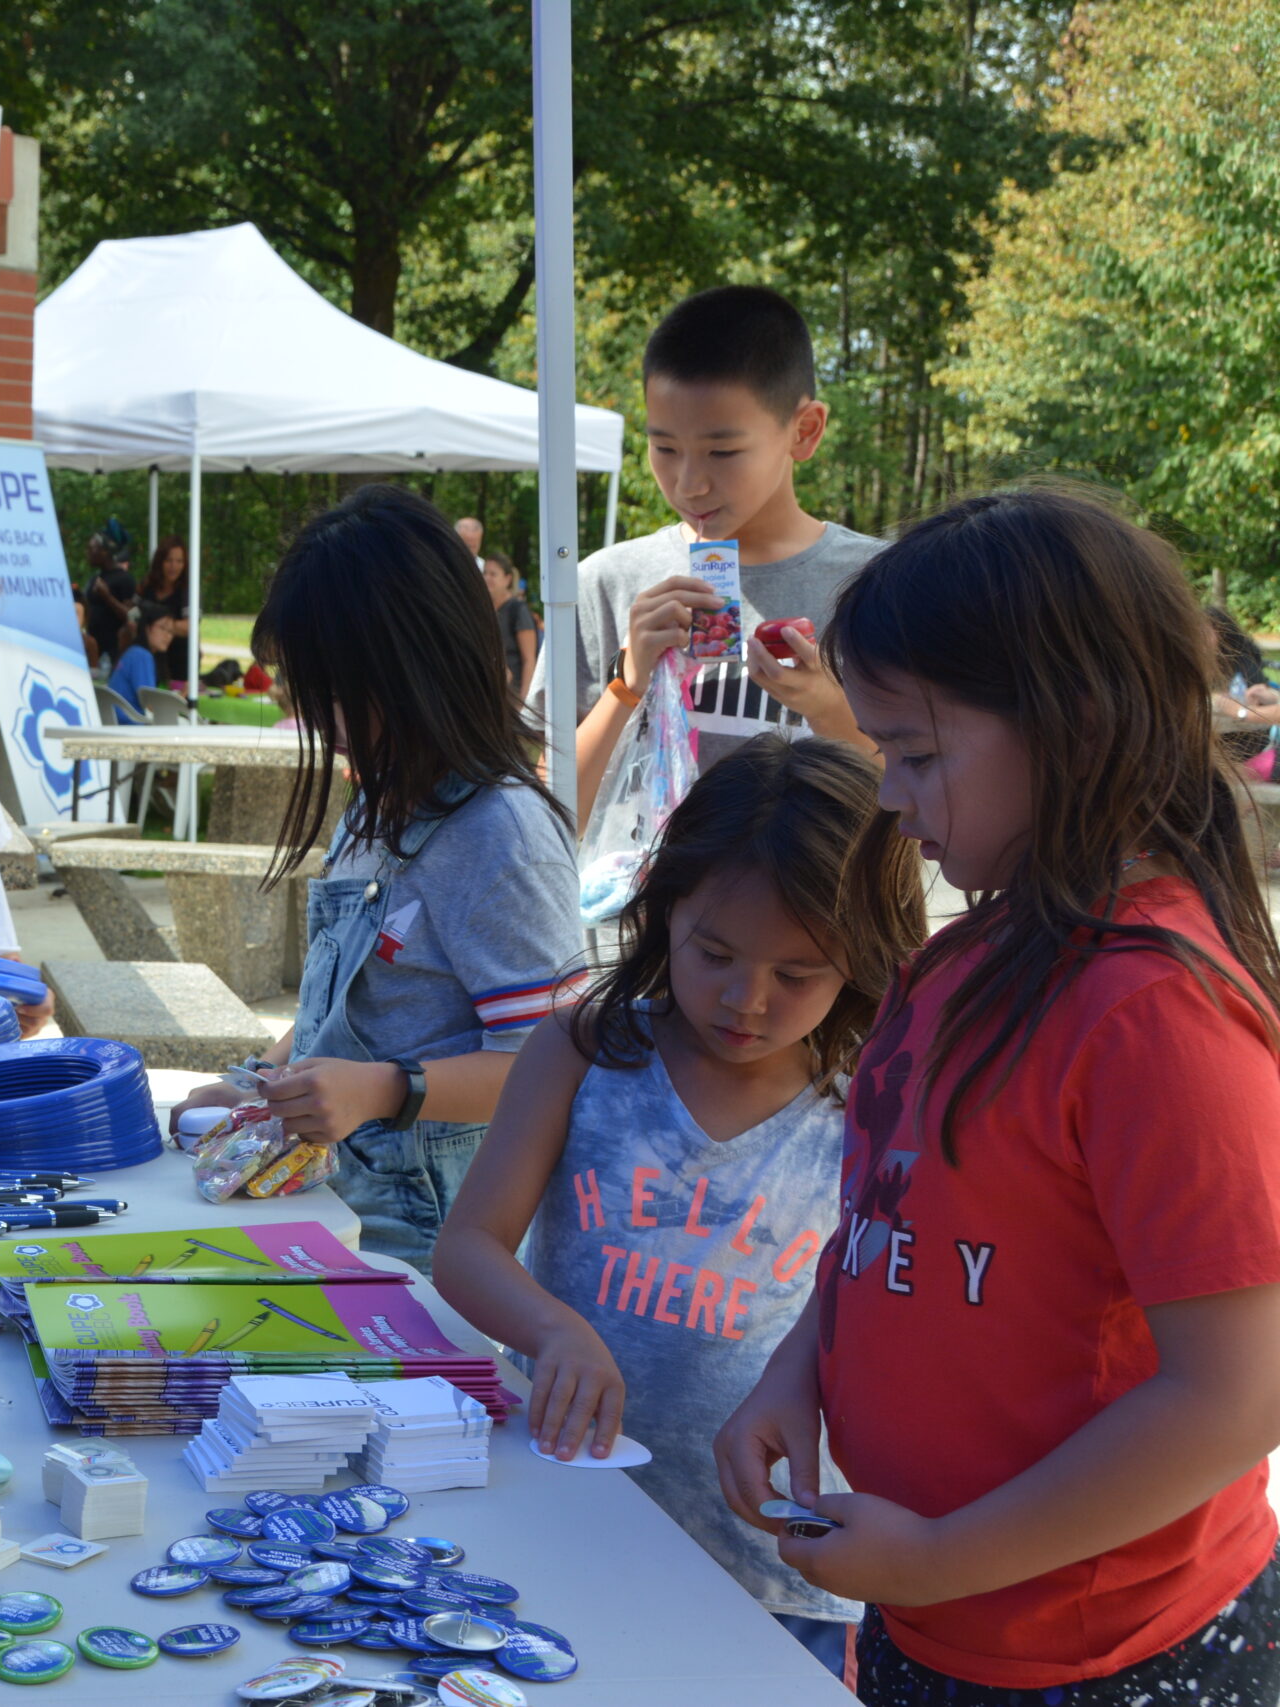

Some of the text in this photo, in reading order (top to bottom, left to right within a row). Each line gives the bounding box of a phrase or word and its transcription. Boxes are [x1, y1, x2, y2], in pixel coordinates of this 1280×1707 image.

[14, 530, 46, 547] BACK
[10, 553, 32, 568] OUR
[692, 561, 736, 573] SunRype
[573, 1167, 820, 1283] HELLO
[839, 1210, 995, 1305] KEY
[596, 1244, 758, 1340] THERE
[117, 1292, 152, 1328] Book
[67, 1312, 100, 1346] CUPE
[267, 1522, 288, 1540] Public
[272, 1515, 300, 1543] child care
[286, 1517, 306, 1535] builds
